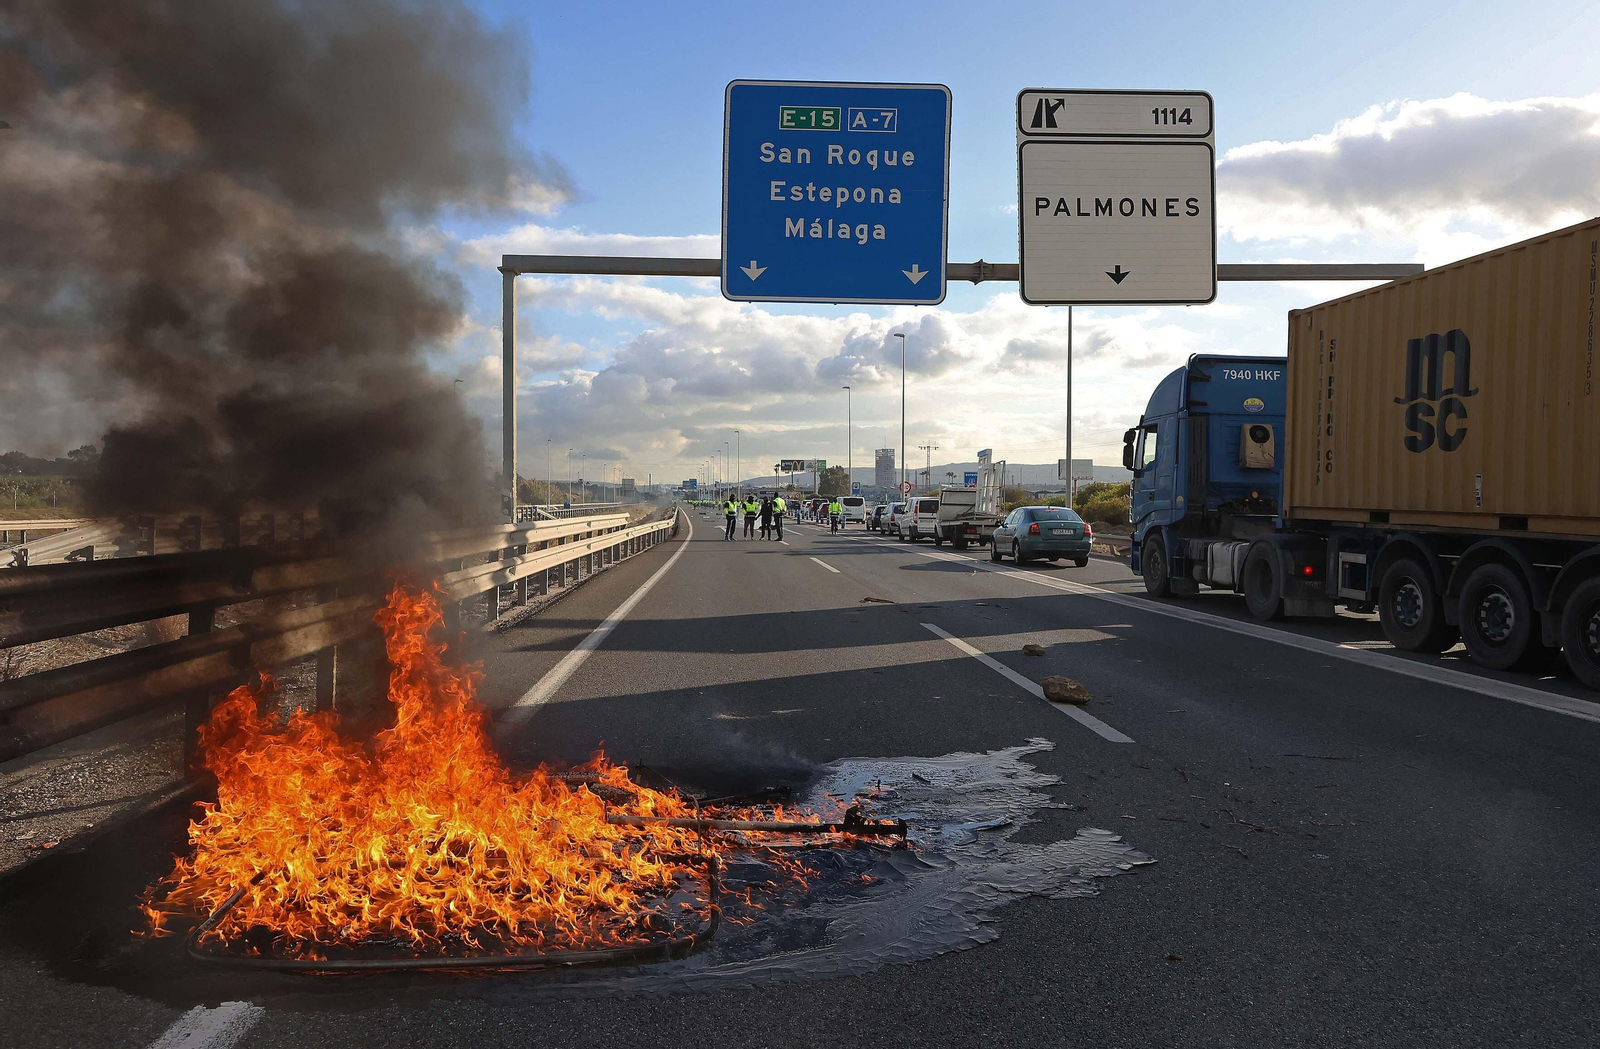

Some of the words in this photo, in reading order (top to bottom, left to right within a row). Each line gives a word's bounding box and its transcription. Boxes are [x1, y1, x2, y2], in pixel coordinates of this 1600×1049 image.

[782, 109, 835, 127] E-15
[852, 111, 894, 129] A-7
[1151, 107, 1194, 126] 1114
[759, 142, 811, 164] San
[827, 144, 916, 171] Roque
[770, 180, 902, 209] Estepona
[1035, 196, 1200, 217] PALMONES
[785, 217, 887, 245] Málaga
[1222, 369, 1252, 380] 7940
[1255, 370, 1282, 382] HKF
[1326, 338, 1336, 437] SHIPPING
